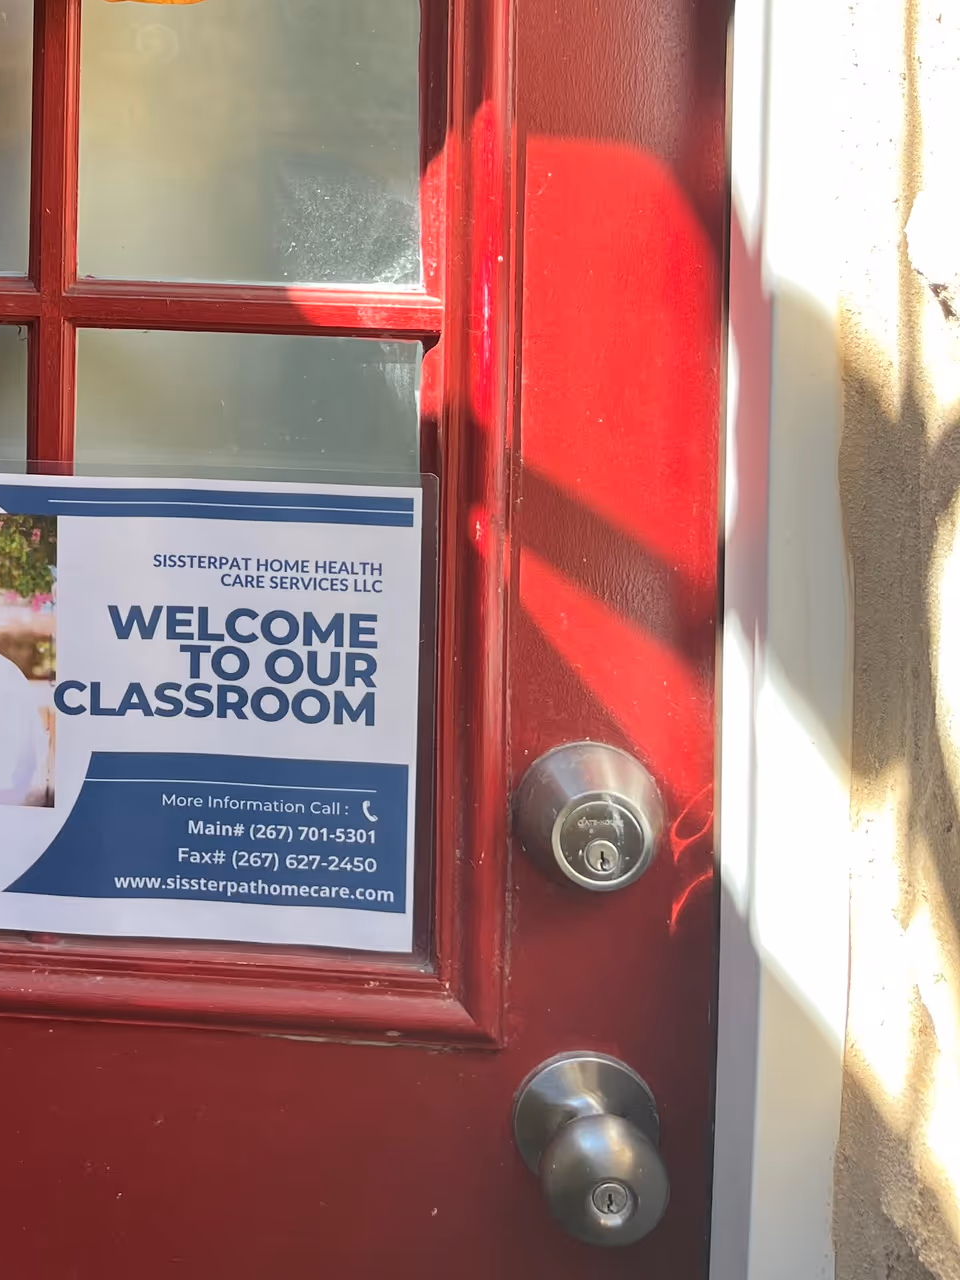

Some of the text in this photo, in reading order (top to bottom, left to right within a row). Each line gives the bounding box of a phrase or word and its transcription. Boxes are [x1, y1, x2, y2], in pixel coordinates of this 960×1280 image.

[152, 553, 383, 577] SISSTERPAT HOME HEALTH
[220, 573, 383, 593] CARE SERVICES LLC
[107, 605, 378, 649] WELCOME
[180, 644, 378, 688] TO OUR
[53, 680, 376, 727] CLASSROOM
[161, 793, 203, 808] More
[208, 796, 305, 815] Information
[309, 801, 341, 816] Call
[187, 819, 377, 844] Main# (267) 701-5301
[177, 847, 377, 873] Fax# (267) 627-2450
[114, 874, 395, 903] www.sissterpathomecare.com
